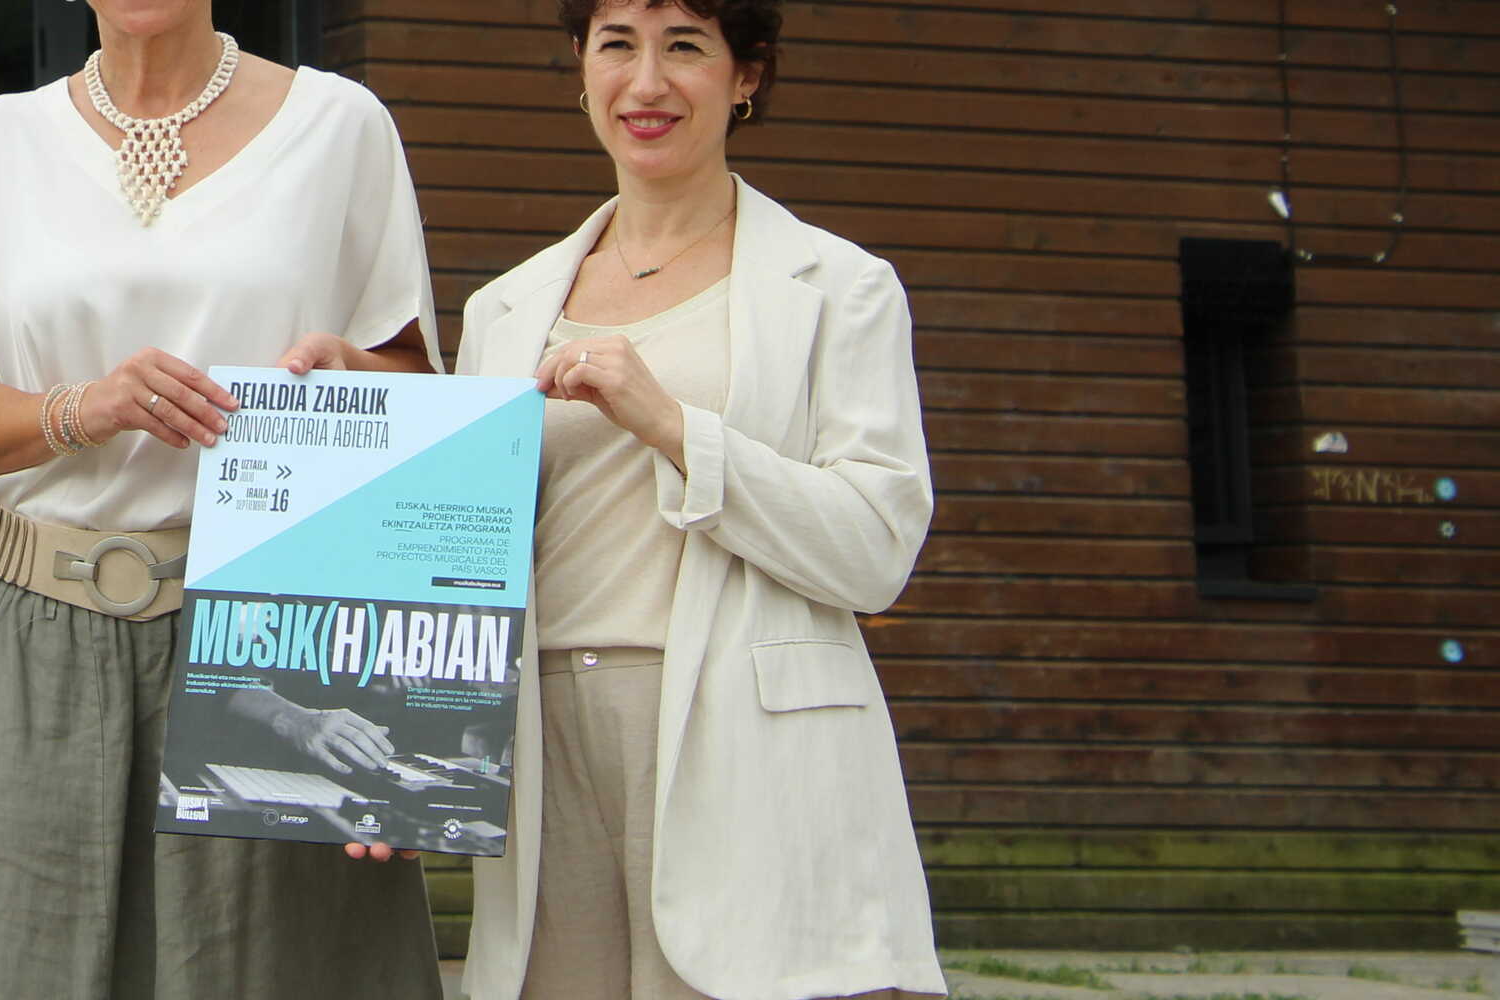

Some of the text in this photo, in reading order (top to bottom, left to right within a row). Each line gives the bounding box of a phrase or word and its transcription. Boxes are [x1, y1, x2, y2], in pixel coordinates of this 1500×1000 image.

[230, 382, 389, 415] DEIALDIA ZABALIK
[225, 414, 389, 449] CONVOCATORIA ABIERTA
[219, 457, 268, 481] 16 UZTAILA
[246, 487, 289, 512] IRAILA 16
[396, 501, 513, 515] EUSKAL HERRIKO MUSIKA
[422, 512, 512, 525] PROIEKTUETARAKO
[382, 519, 511, 534] EKINTZAILETZA PROGRAMA
[440, 535, 509, 547] PROGRAMA DE
[398, 542, 508, 556] EMPRENDIMIENTO PARA
[376, 551, 507, 566] PROYECTOS MUSICALES DEL
[474, 565, 507, 576] VASCO
[188, 598, 510, 688] MUSIK(H)ABIAN
